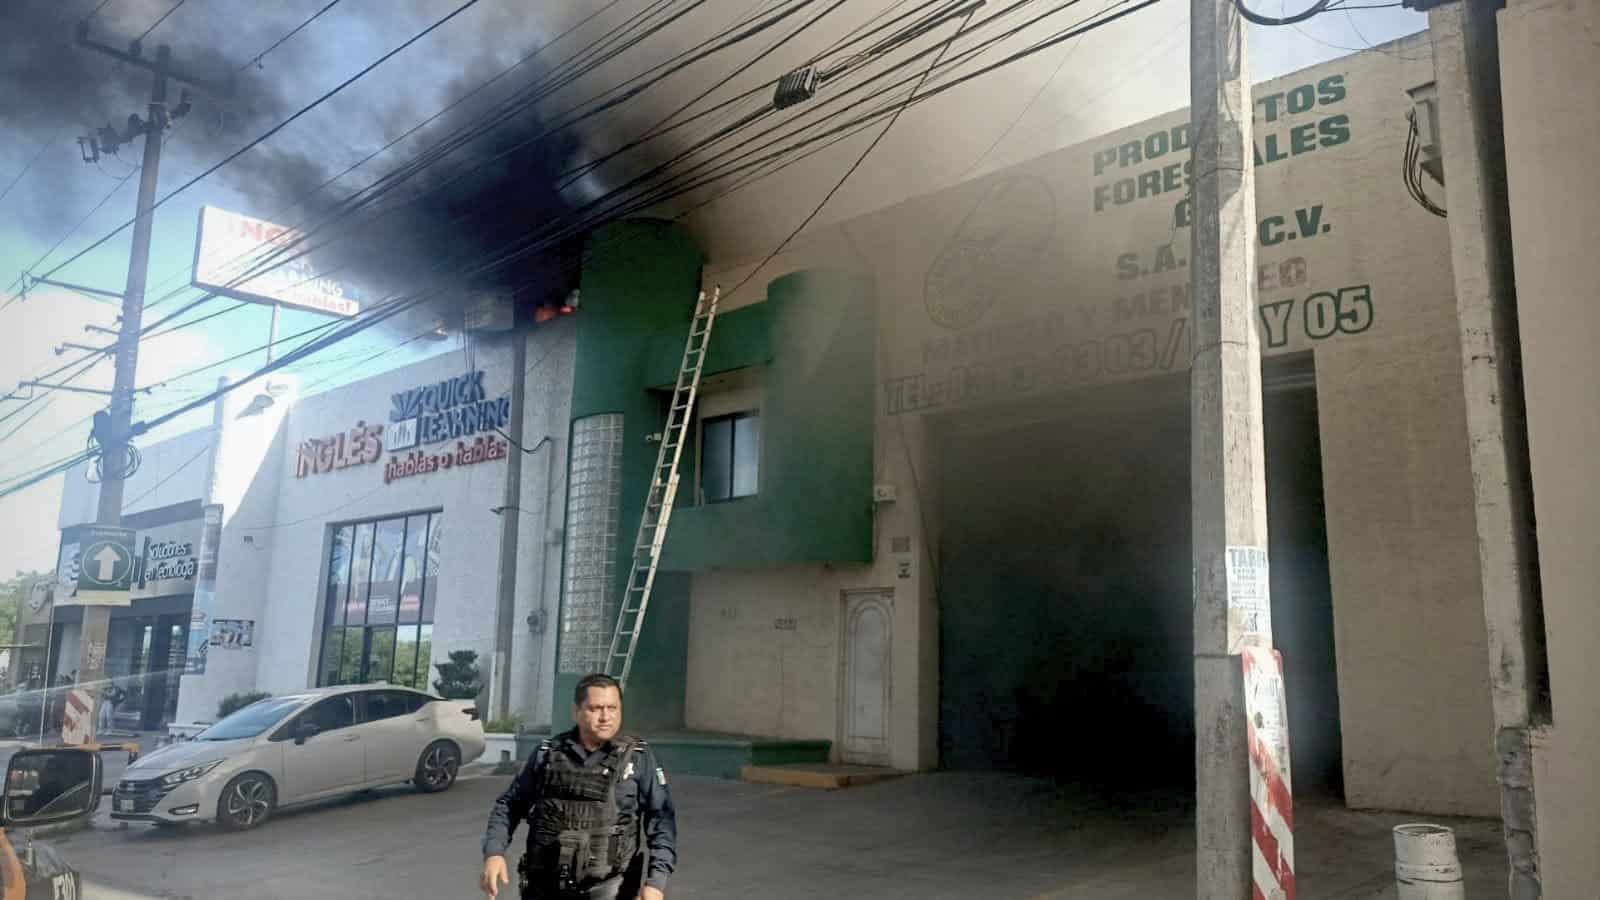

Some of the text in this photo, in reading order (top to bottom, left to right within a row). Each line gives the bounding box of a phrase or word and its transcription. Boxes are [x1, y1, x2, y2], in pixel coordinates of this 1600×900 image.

[1093, 74, 1347, 177] PRODTOS
[1116, 204, 1332, 282] S.A. C.V.
[1259, 302, 1294, 348] Y
[1303, 284, 1375, 340] 05
[418, 371, 486, 413] QUICK
[439, 453, 453, 469] o
